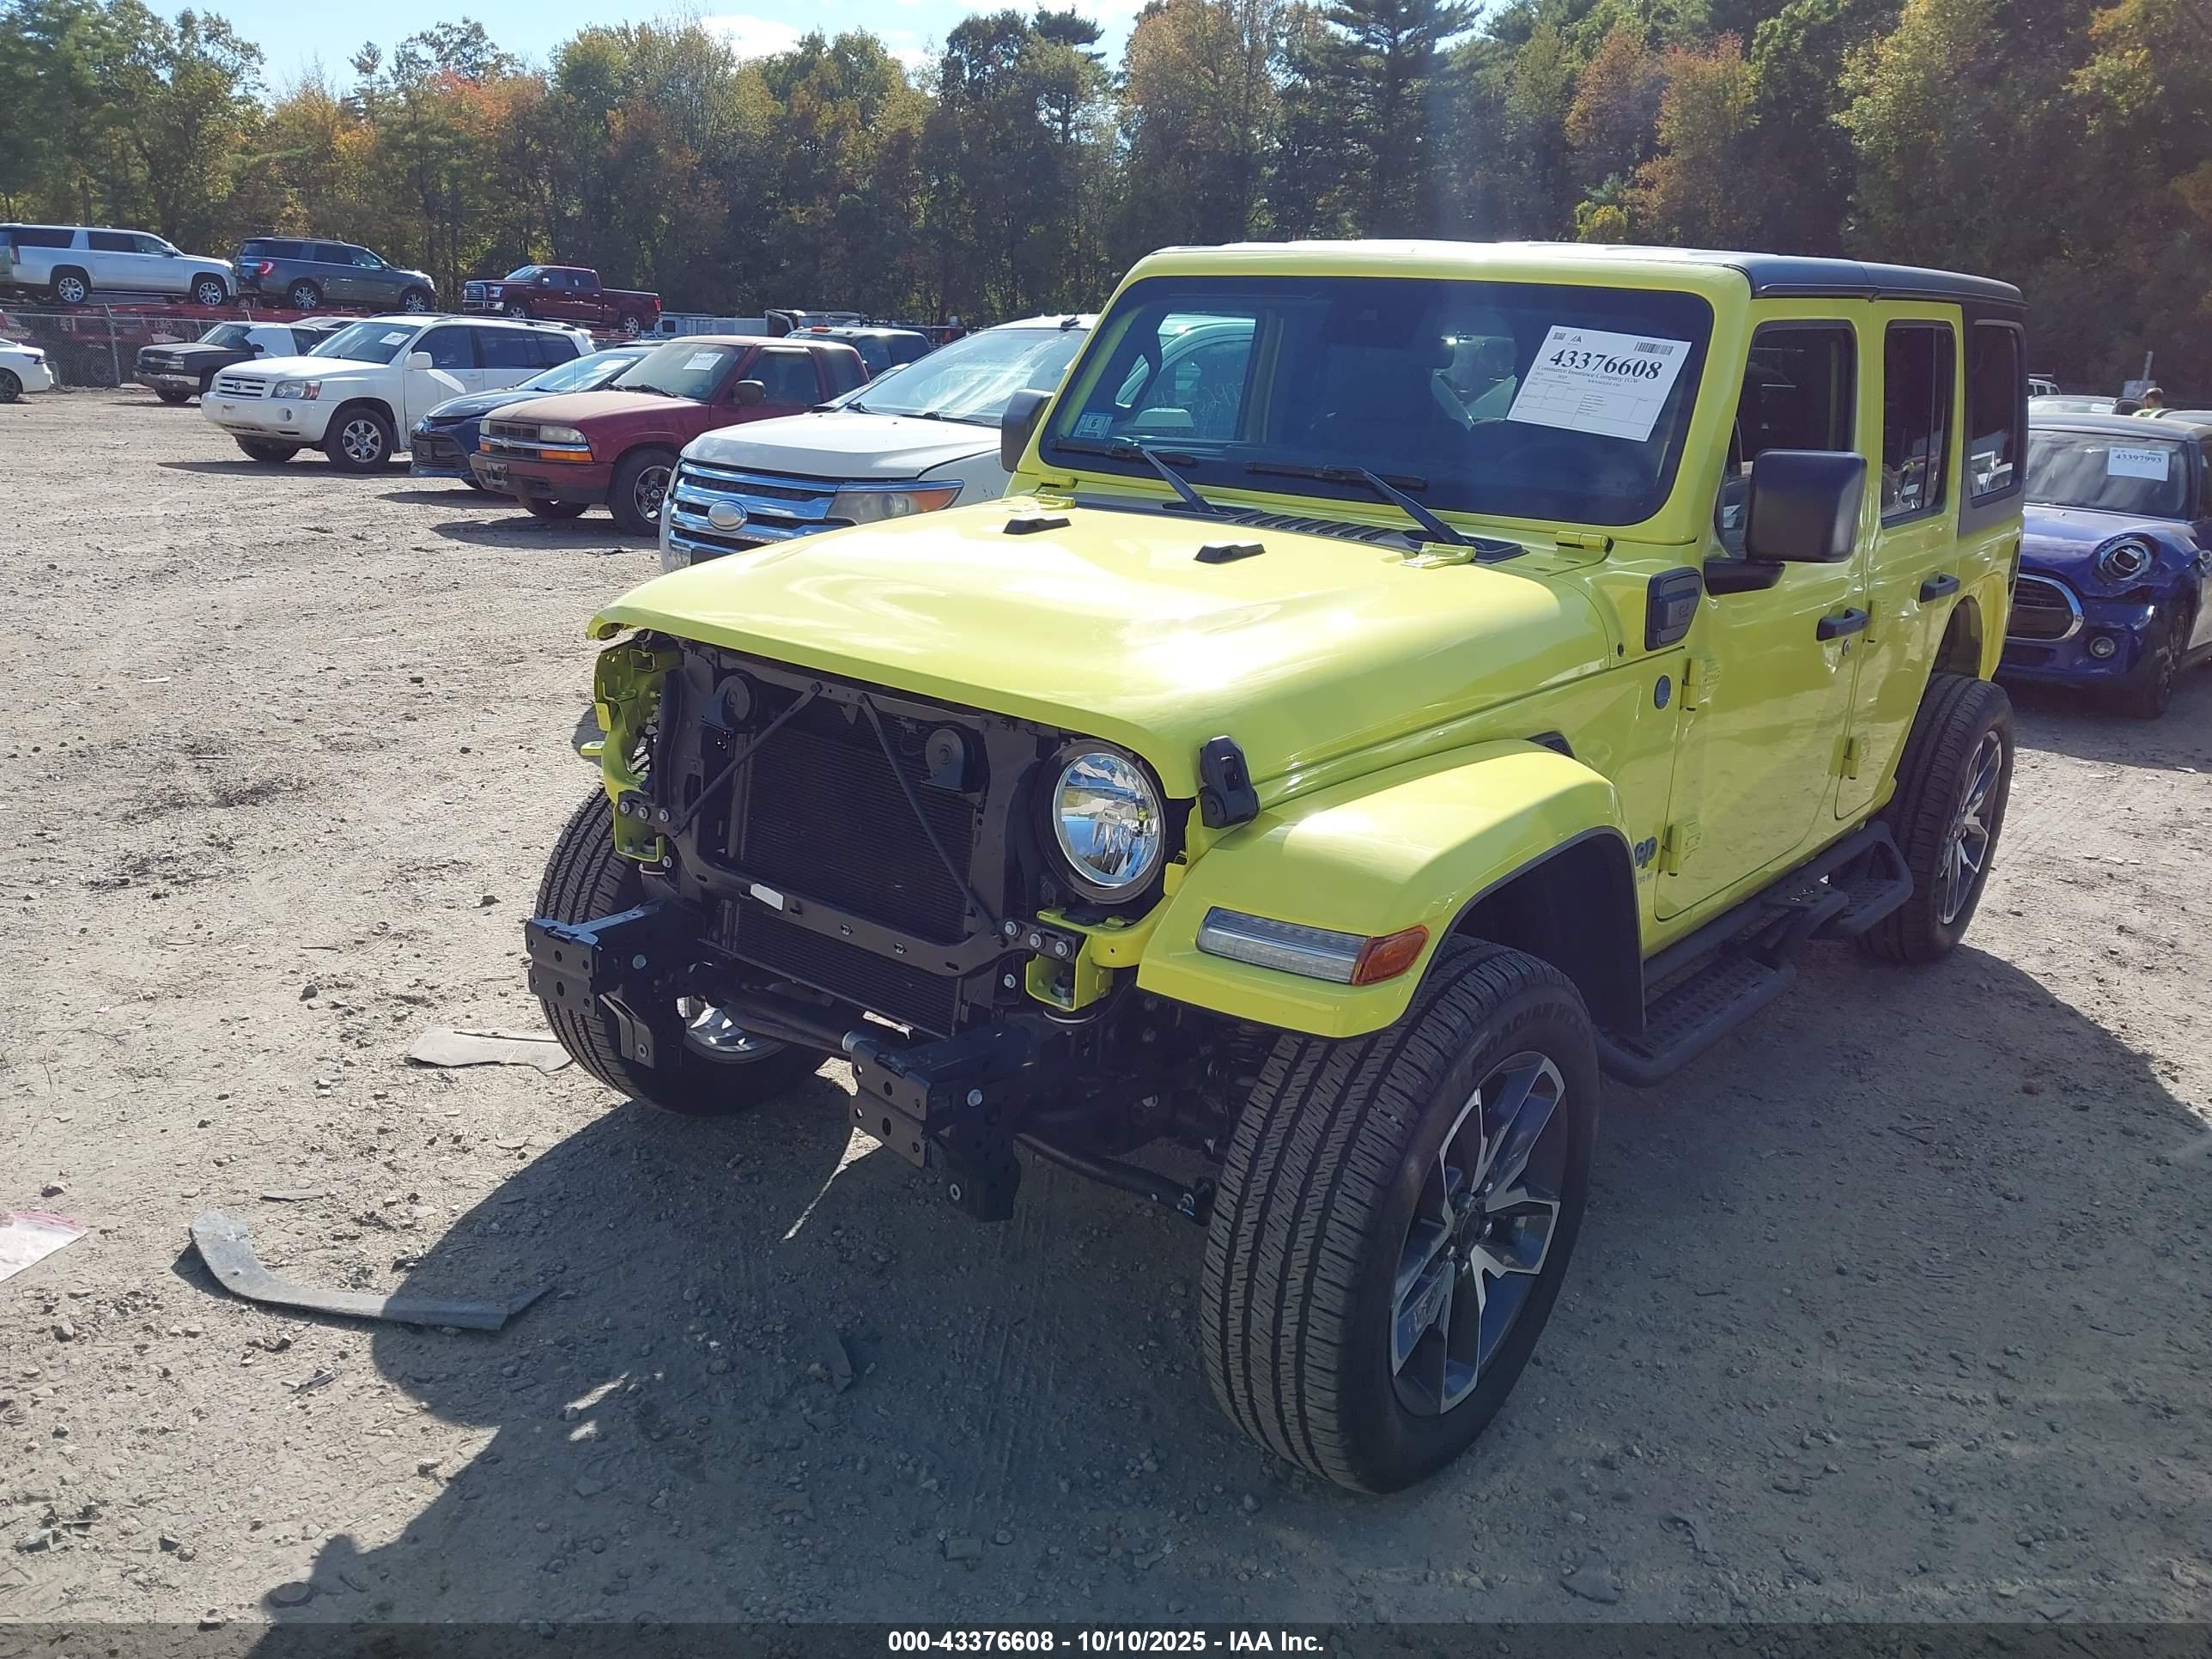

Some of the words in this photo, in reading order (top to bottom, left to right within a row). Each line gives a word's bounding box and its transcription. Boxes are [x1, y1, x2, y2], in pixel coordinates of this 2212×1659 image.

[1550, 349, 1662, 380] 43376608
[1537, 365, 1567, 374] Commerce
[1568, 369, 1595, 378] Insurance
[1596, 373, 1621, 383] Company
[1091, 418, 1098, 428] 6
